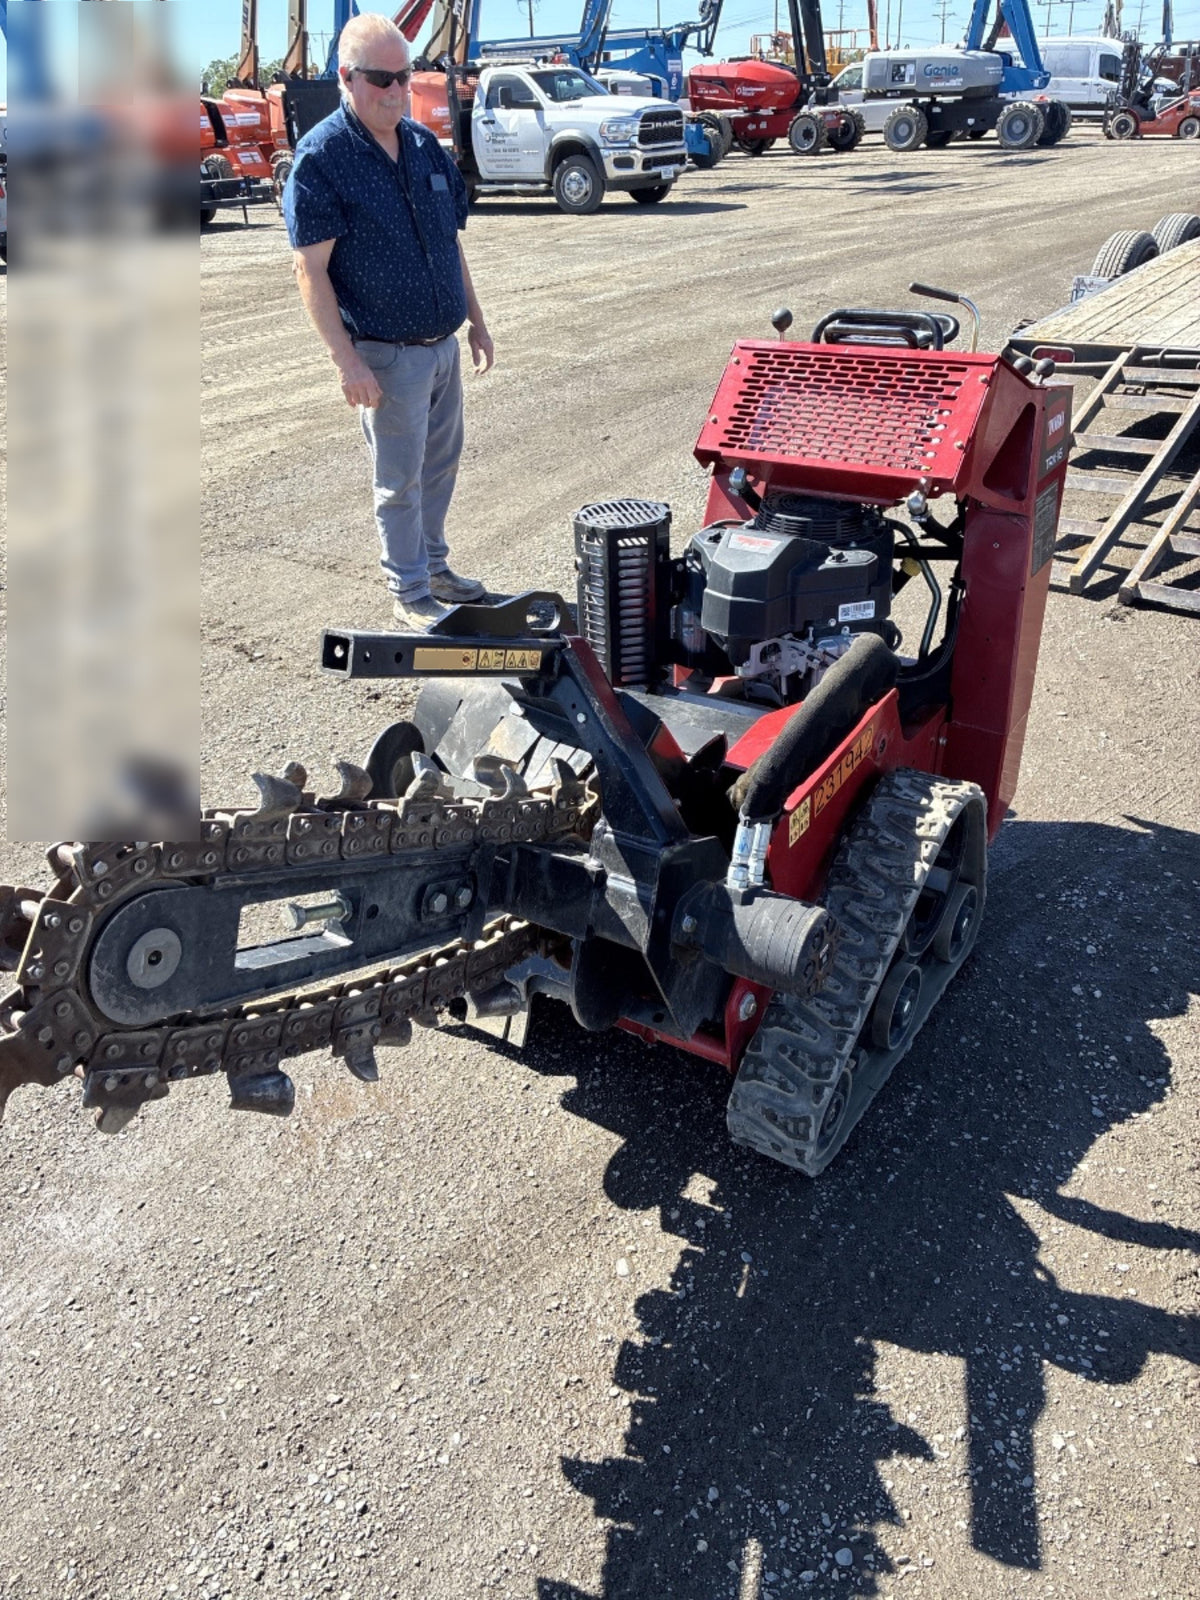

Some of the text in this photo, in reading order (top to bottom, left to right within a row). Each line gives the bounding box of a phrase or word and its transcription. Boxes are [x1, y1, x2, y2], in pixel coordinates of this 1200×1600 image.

[924, 64, 960, 77] Genie
[655, 120, 674, 128] RAM
[1048, 411, 1065, 437] TORO
[815, 728, 874, 812] 231942
